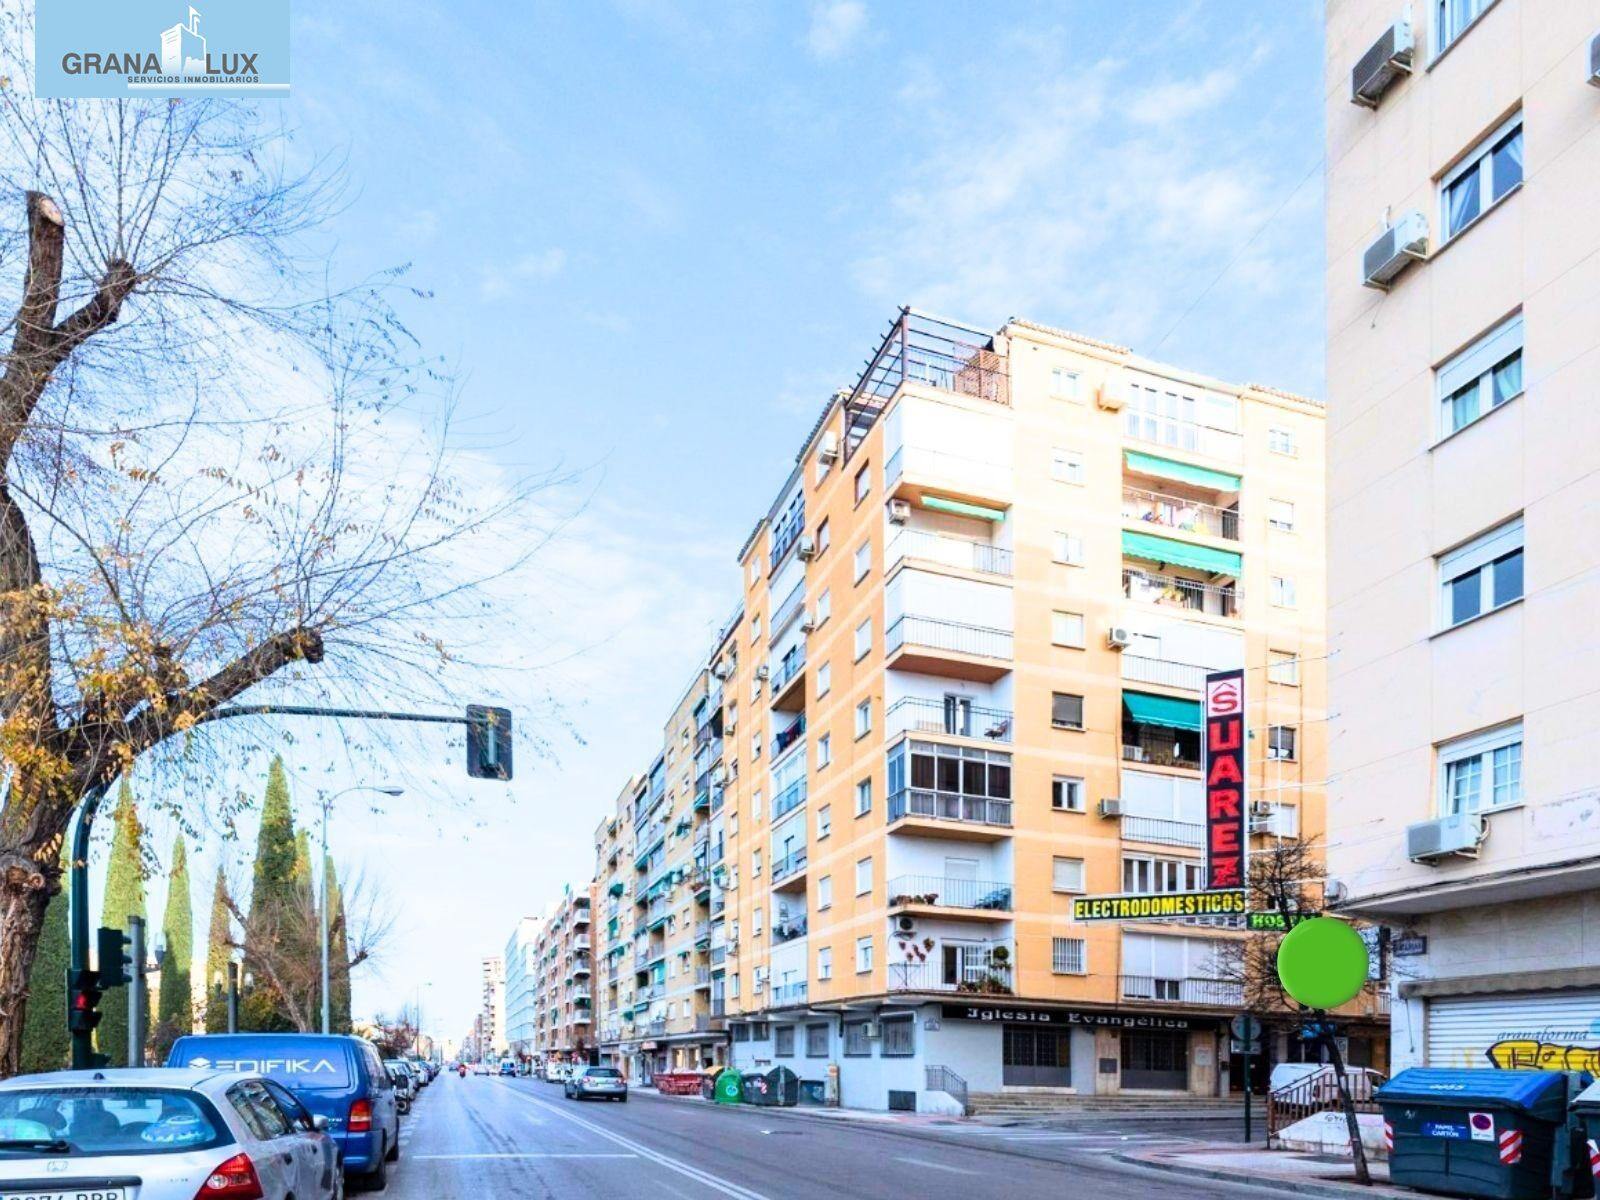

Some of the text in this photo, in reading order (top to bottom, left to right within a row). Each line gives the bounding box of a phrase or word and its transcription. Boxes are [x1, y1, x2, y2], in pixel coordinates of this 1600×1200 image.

[1207, 689, 1242, 886] SUAREZ
[1075, 893, 1244, 919] ELECTRODOMESTICOS
[216, 1058, 337, 1074] EDIFIKA
